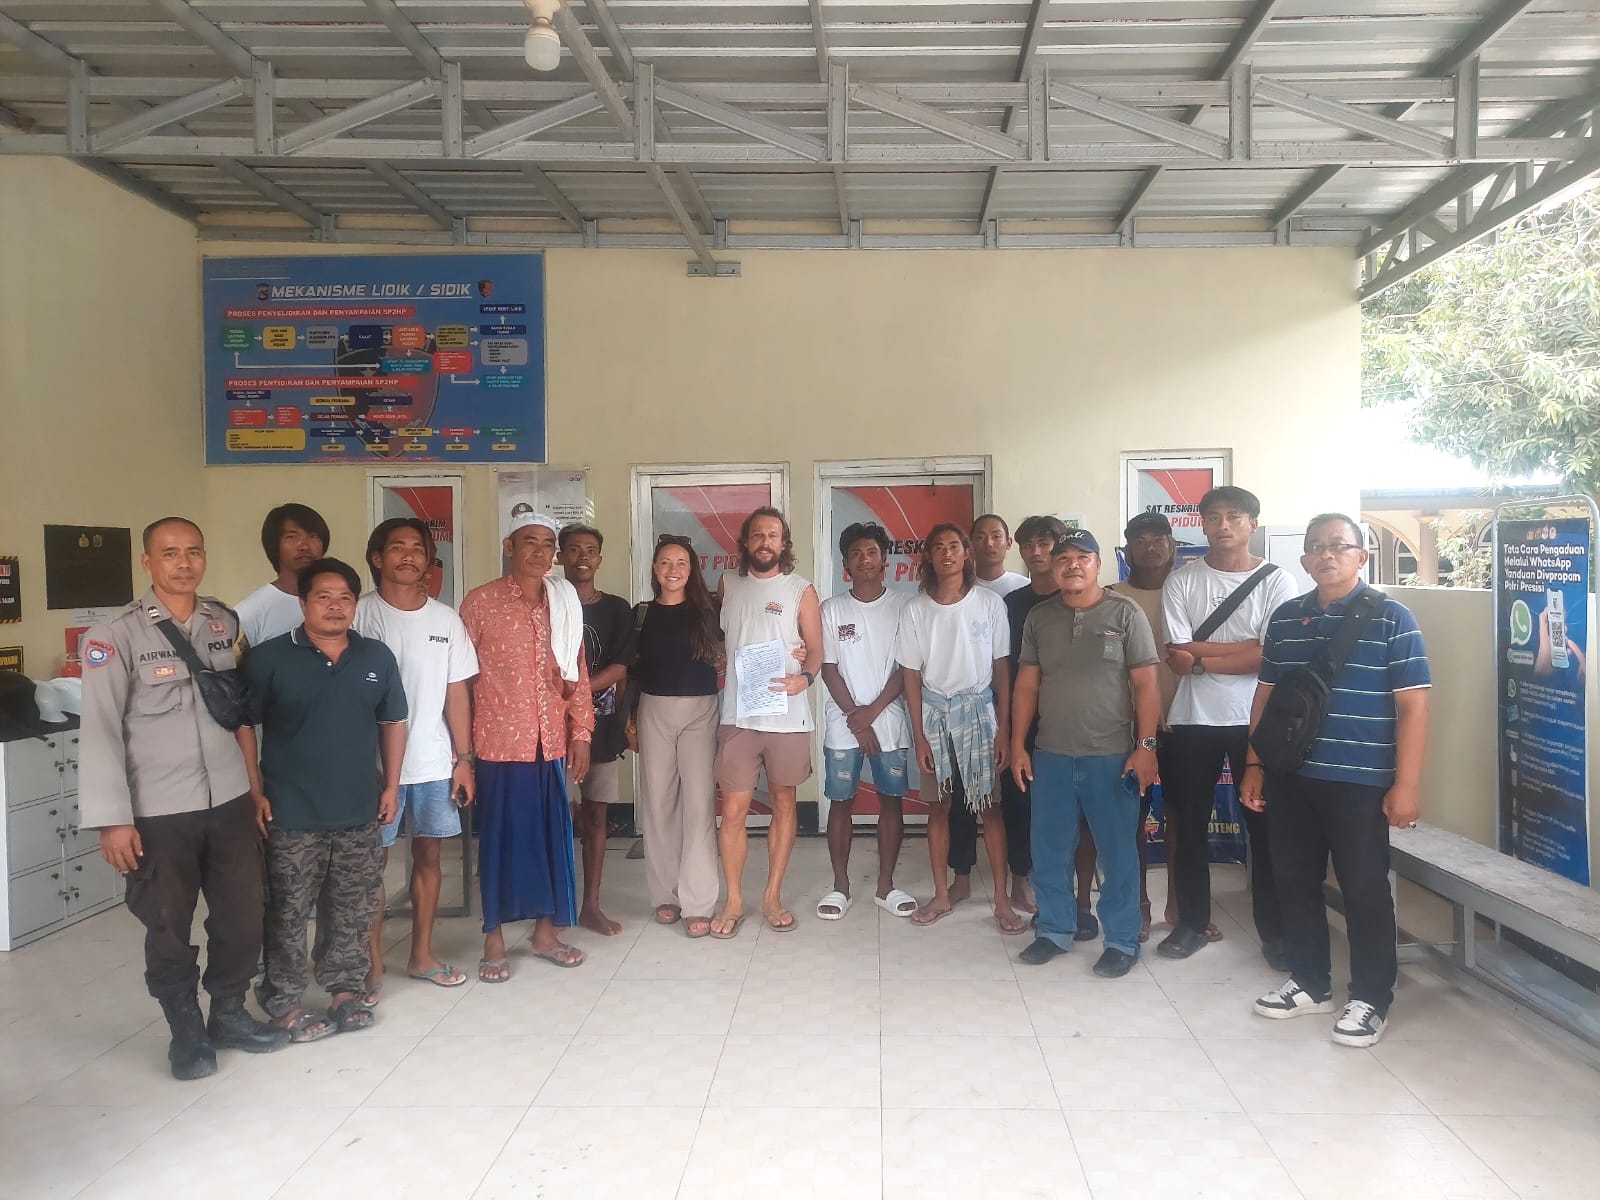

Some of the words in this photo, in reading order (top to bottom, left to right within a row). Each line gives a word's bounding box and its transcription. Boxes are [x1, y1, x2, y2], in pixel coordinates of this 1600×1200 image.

[271, 284, 366, 298] MEKANISME
[371, 284, 410, 296] LIDIK
[430, 283, 472, 296] SIDIK
[1145, 504, 1163, 514] SAT
[887, 540, 926, 555] RESK
[1503, 543, 1520, 554] Tata
[1520, 543, 1539, 554] Cara
[1540, 542, 1585, 557] Pengaduan
[1504, 556, 1529, 567] Melalui
[1529, 557, 1572, 571] WhatsApp
[1504, 568, 1536, 580] Yanduan
[1536, 569, 1581, 585] Divpropam
[1504, 580, 1519, 591] Polri
[1520, 582, 1545, 593] Presisi
[1207, 822, 1241, 834] OTENG
